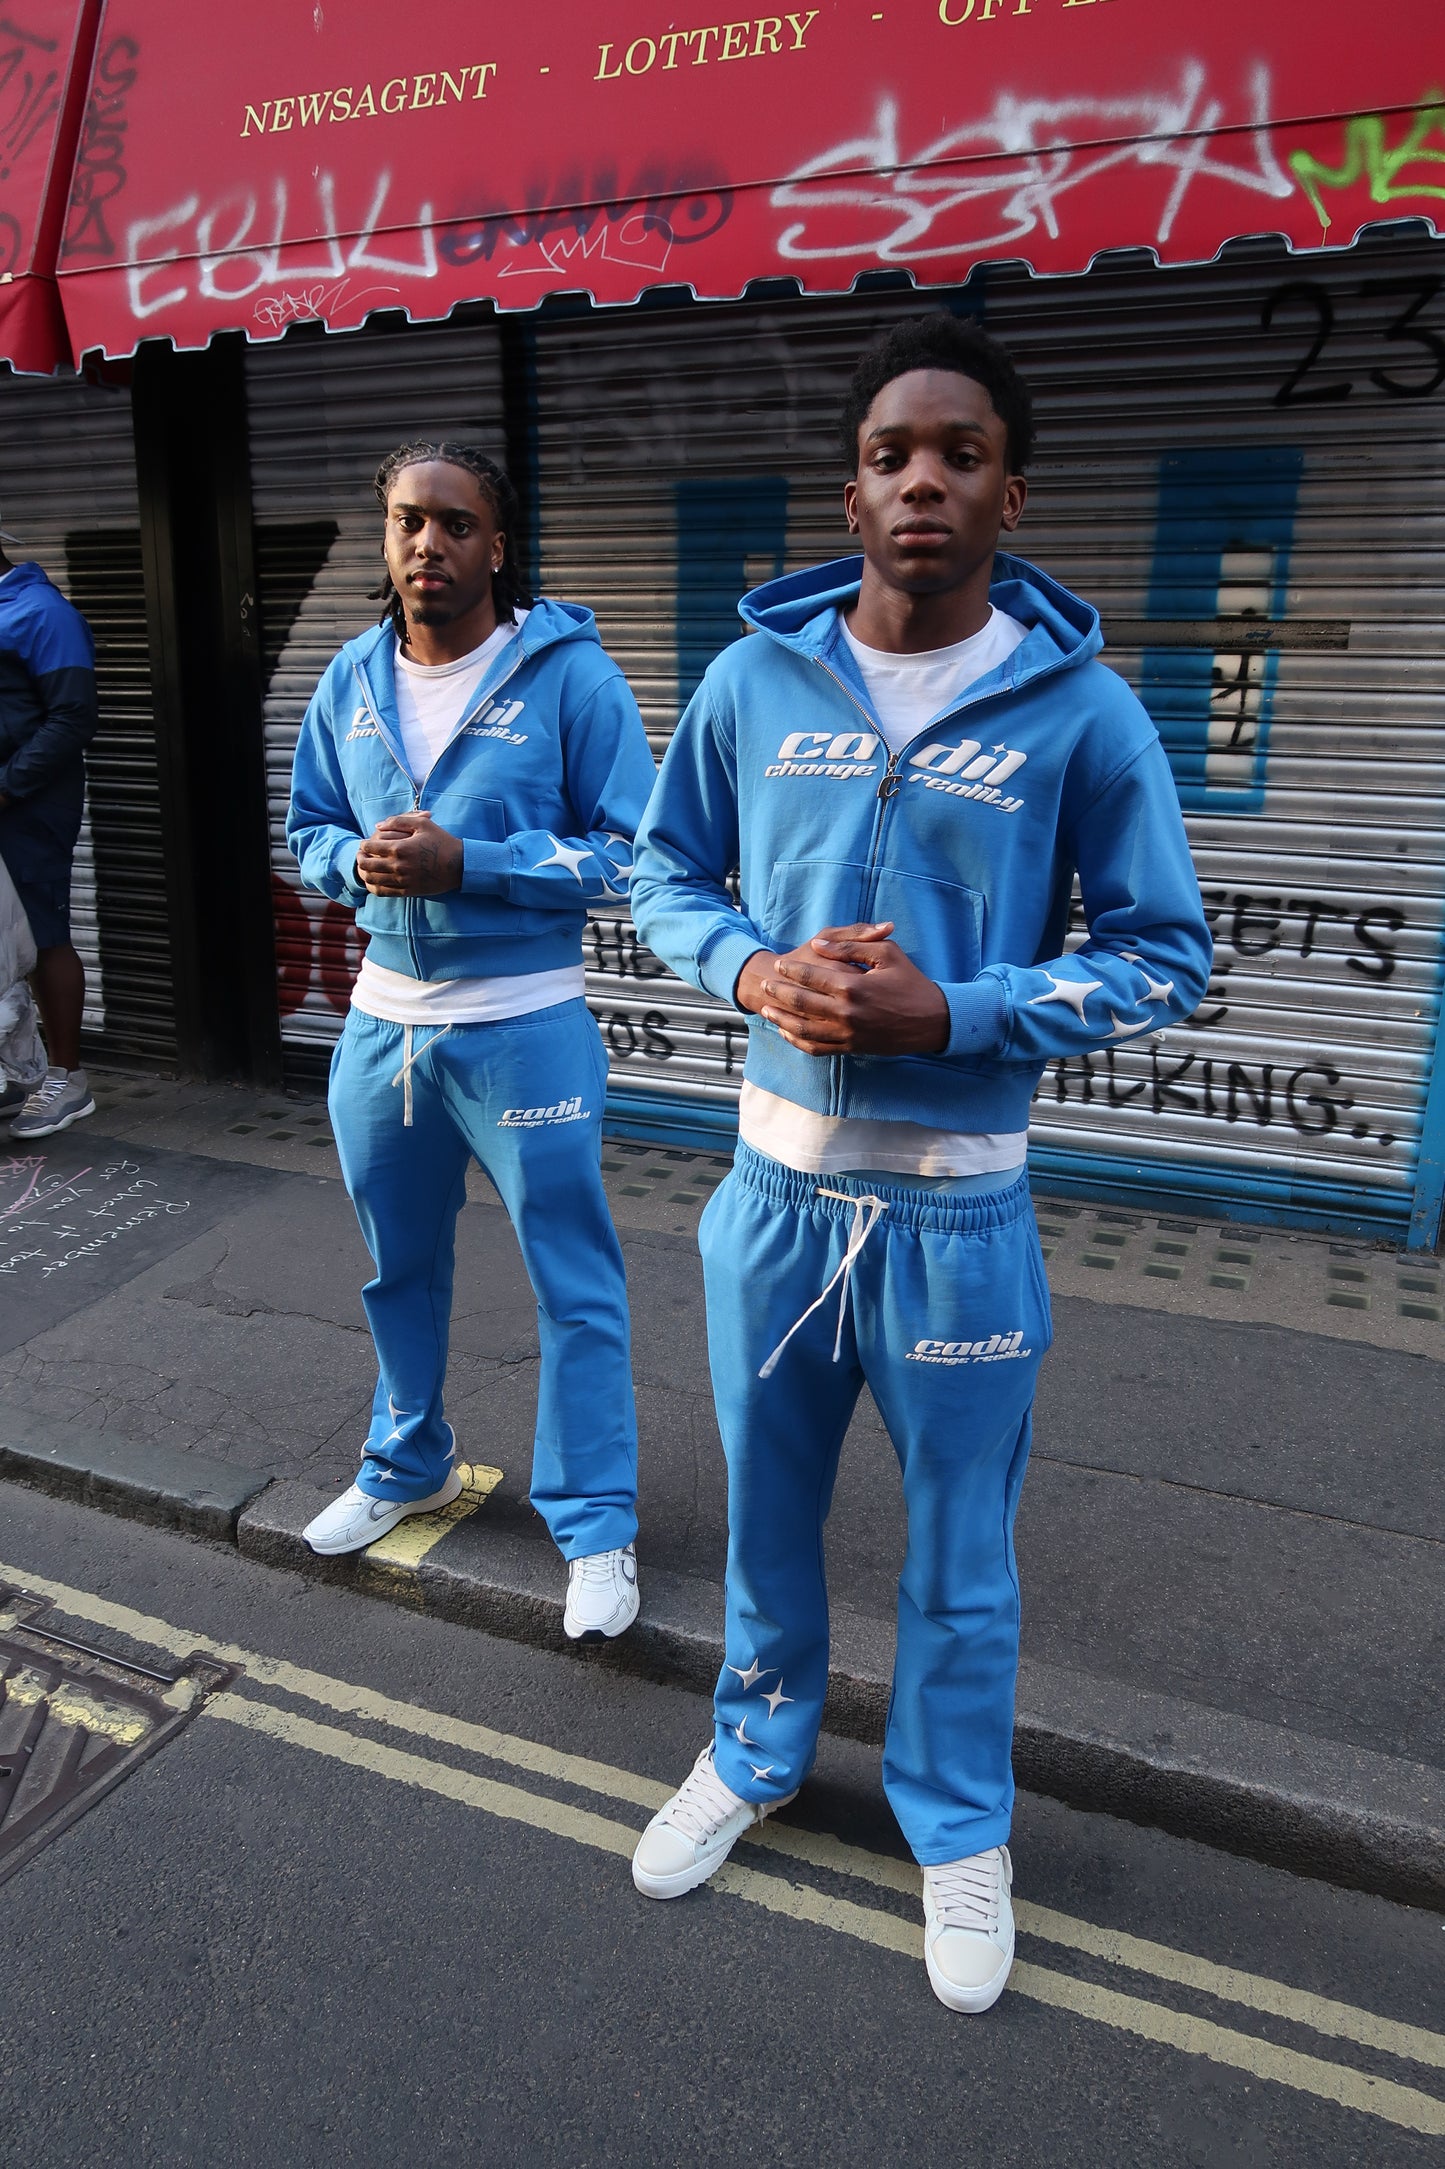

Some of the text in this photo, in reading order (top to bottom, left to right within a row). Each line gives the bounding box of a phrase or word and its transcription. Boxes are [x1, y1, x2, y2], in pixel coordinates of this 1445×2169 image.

[240, 63, 497, 138] NEWSAGENT
[593, 10, 820, 81] LOTTERY
[463, 726, 529, 746] eality
[764, 760, 1025, 814] change reality
[496, 1110, 591, 1129] change reality
[502, 1096, 582, 1121] cadil
[914, 1330, 1024, 1356] cadil
[904, 1348, 1032, 1366] change reality
